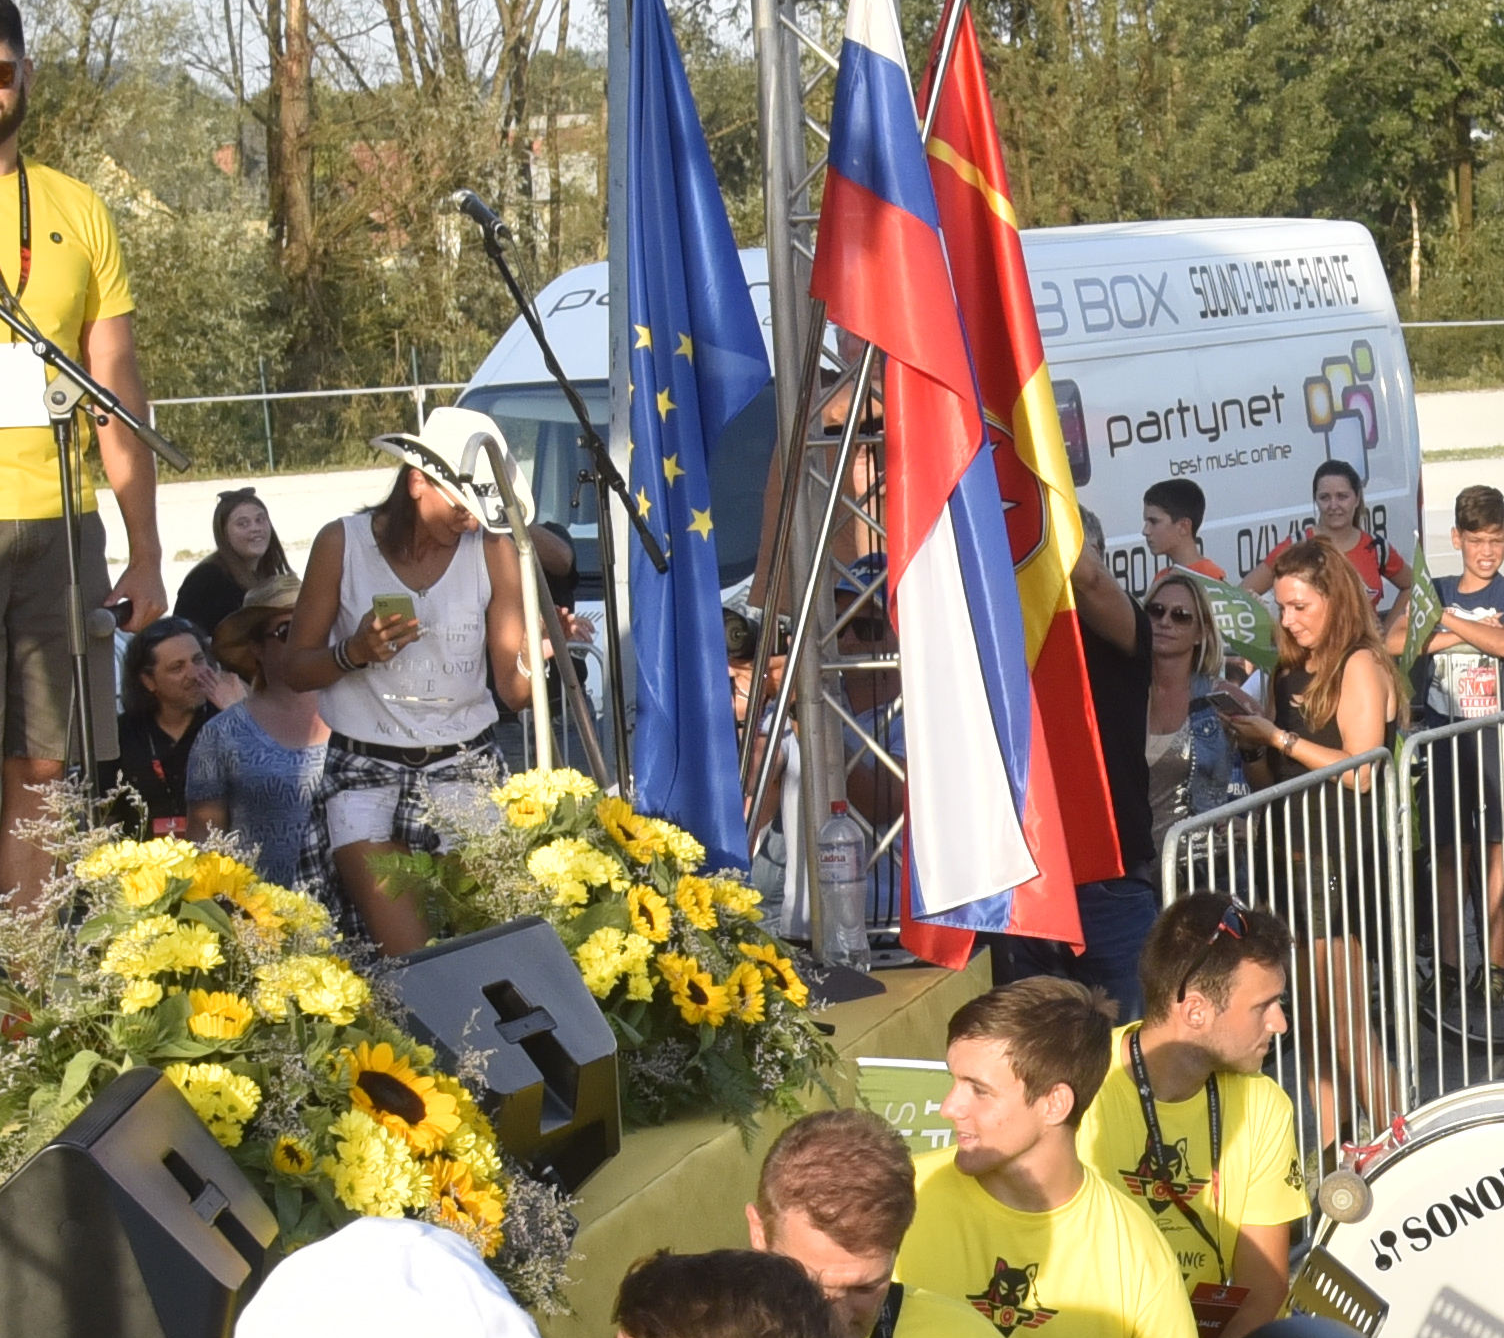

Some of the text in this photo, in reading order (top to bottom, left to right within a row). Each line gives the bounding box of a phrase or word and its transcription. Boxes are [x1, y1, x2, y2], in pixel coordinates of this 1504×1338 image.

[1073, 271, 1180, 334] BOX
[1105, 384, 1285, 458] partynet
[1169, 444, 1293, 477] best music online
